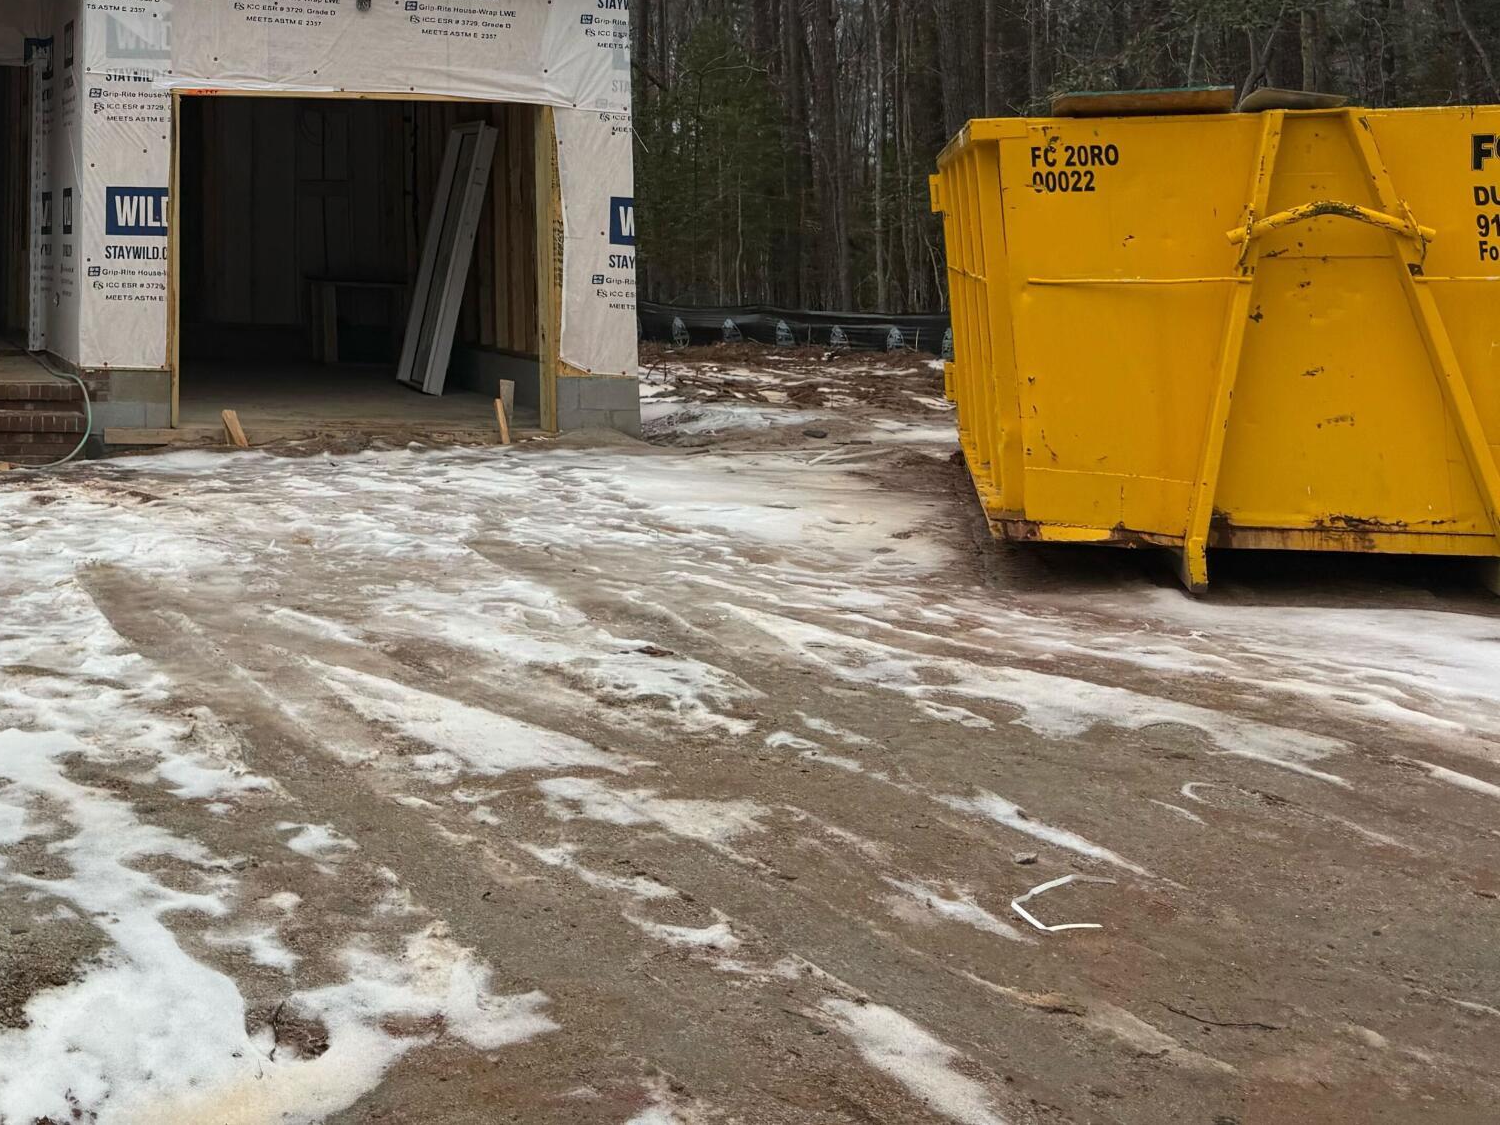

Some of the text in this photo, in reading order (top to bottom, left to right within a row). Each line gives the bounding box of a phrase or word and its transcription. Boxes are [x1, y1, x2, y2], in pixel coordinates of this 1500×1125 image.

[1031, 144, 1119, 167] FC 20RO
[1032, 170, 1096, 193] 00022
